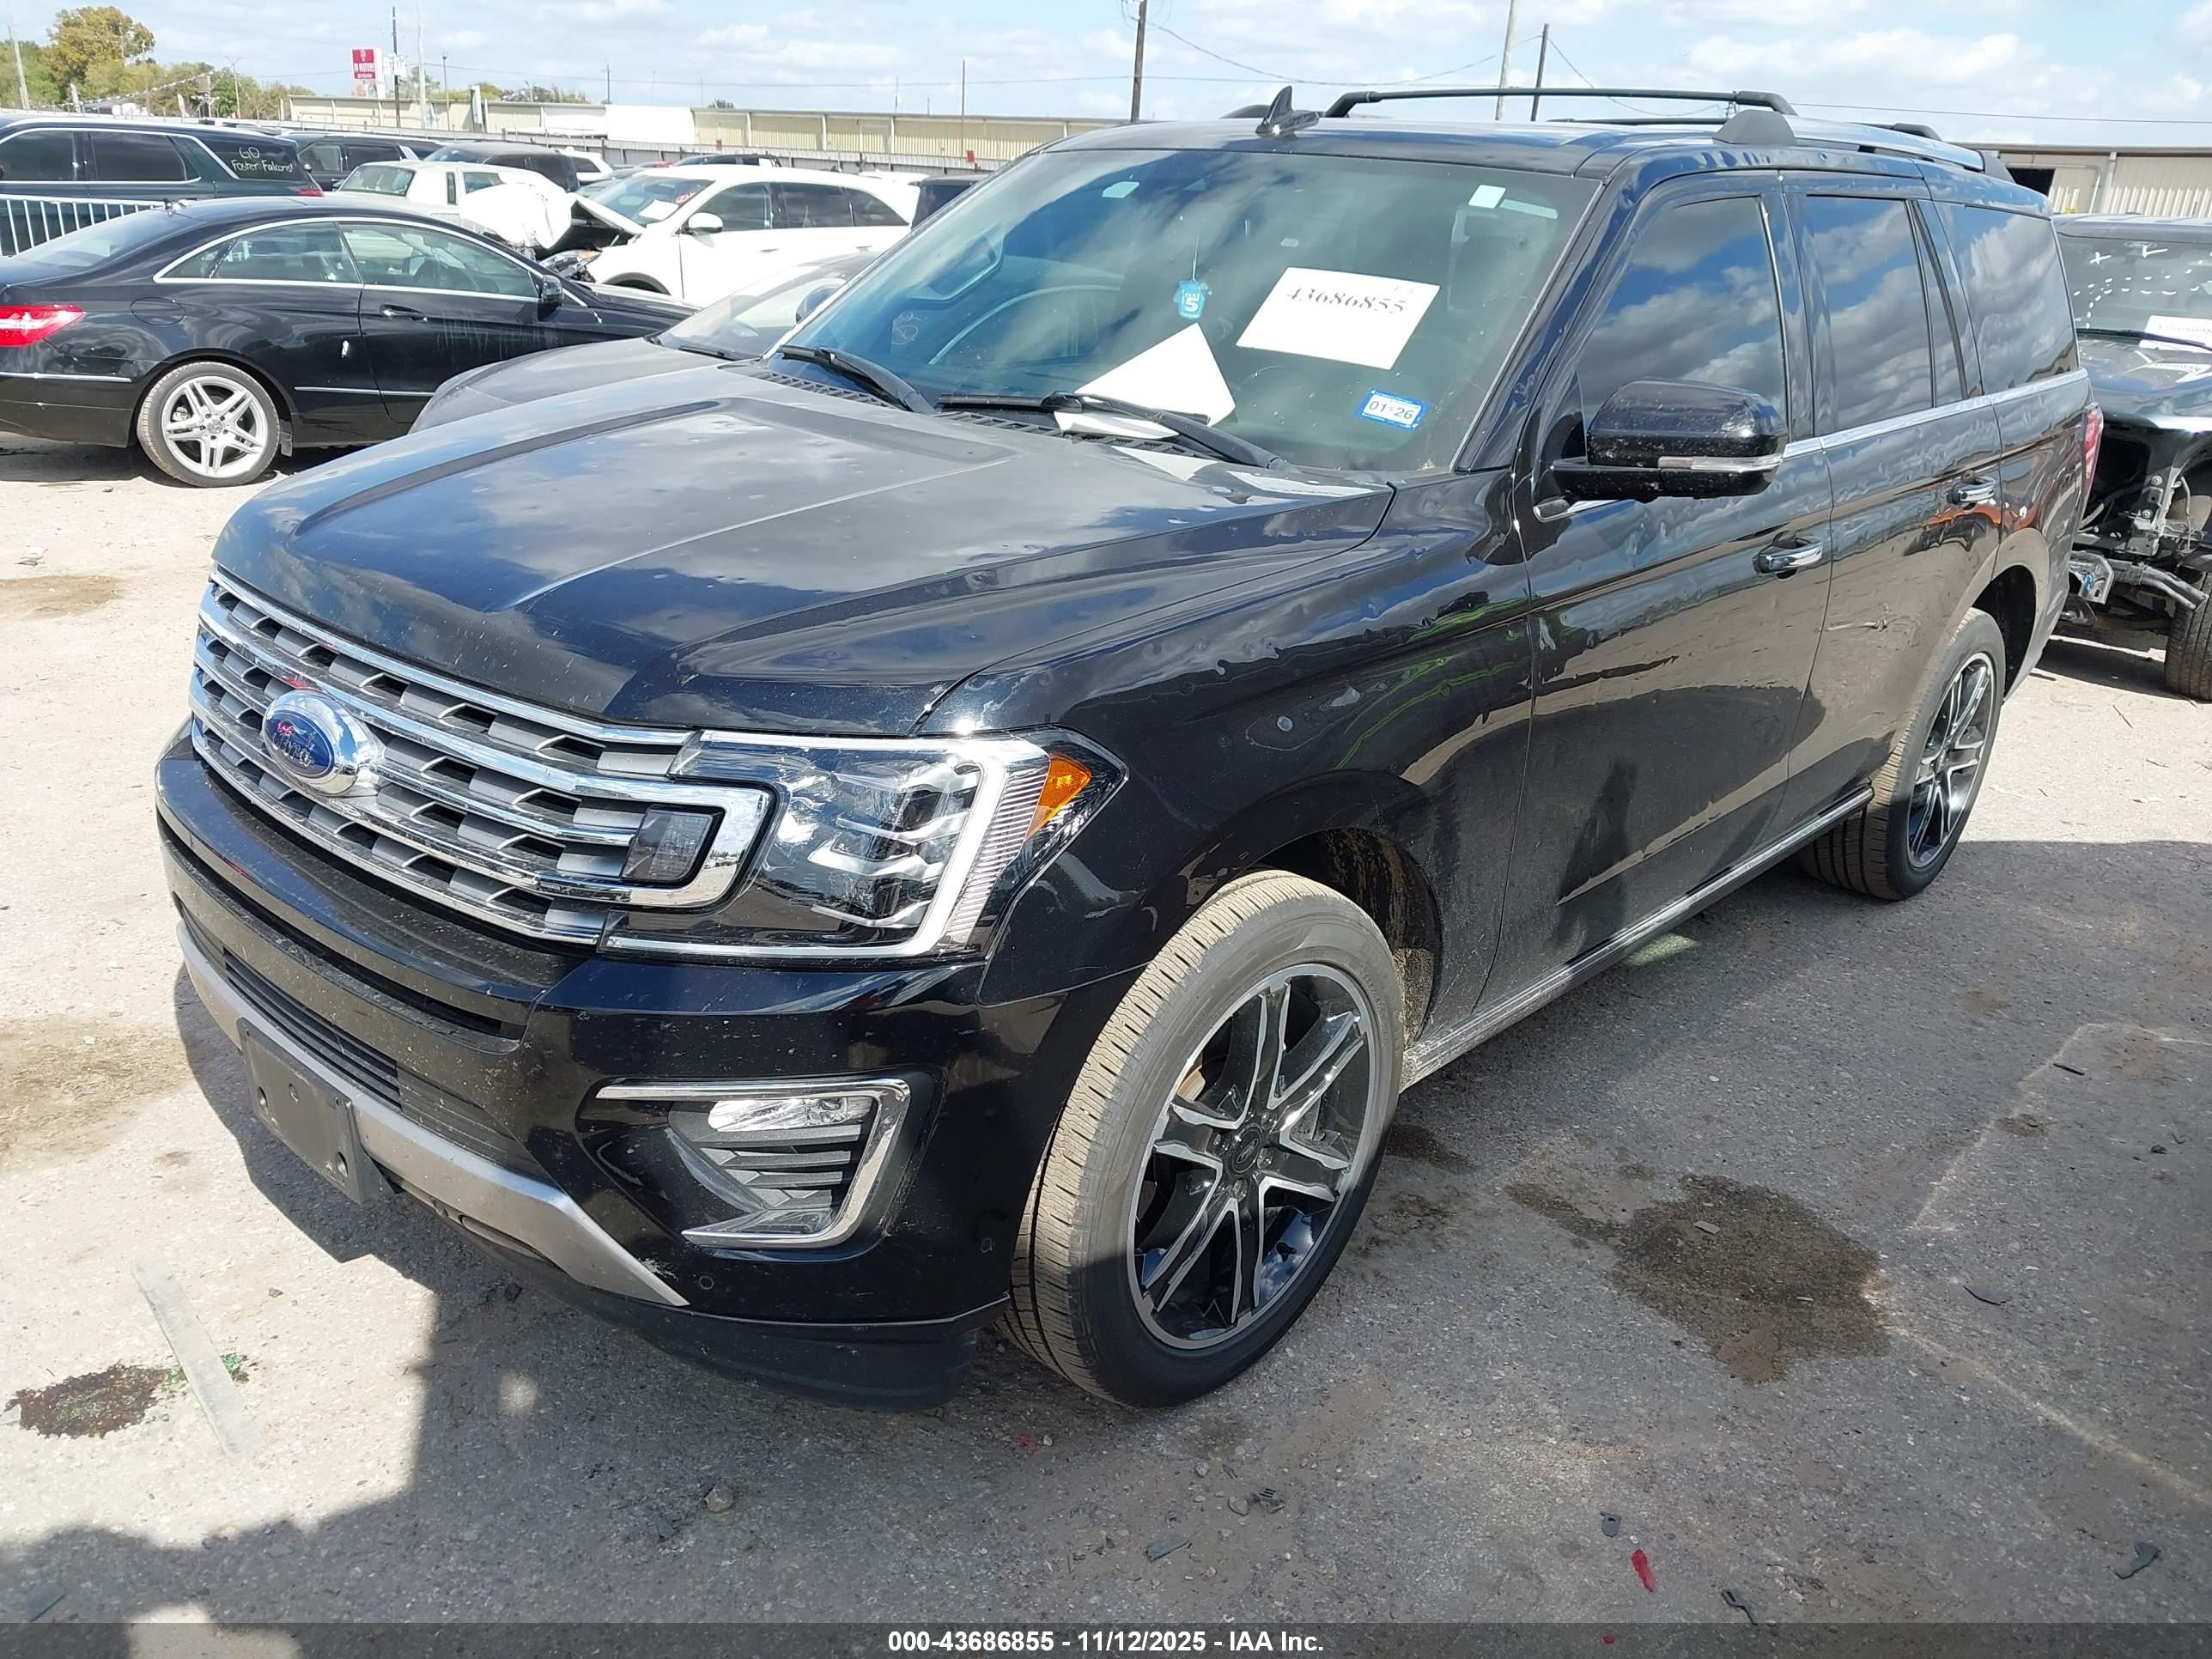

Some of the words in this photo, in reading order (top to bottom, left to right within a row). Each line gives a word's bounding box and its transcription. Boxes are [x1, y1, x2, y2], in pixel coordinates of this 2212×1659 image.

[239, 146, 260, 159] GO
[231, 159, 258, 172] Foster
[1185, 297, 1200, 313] 5
[1286, 288, 1407, 314] 43686855
[1369, 401, 1388, 413] 01
[1394, 407, 1414, 419] 26
[271, 720, 317, 768] Ford
